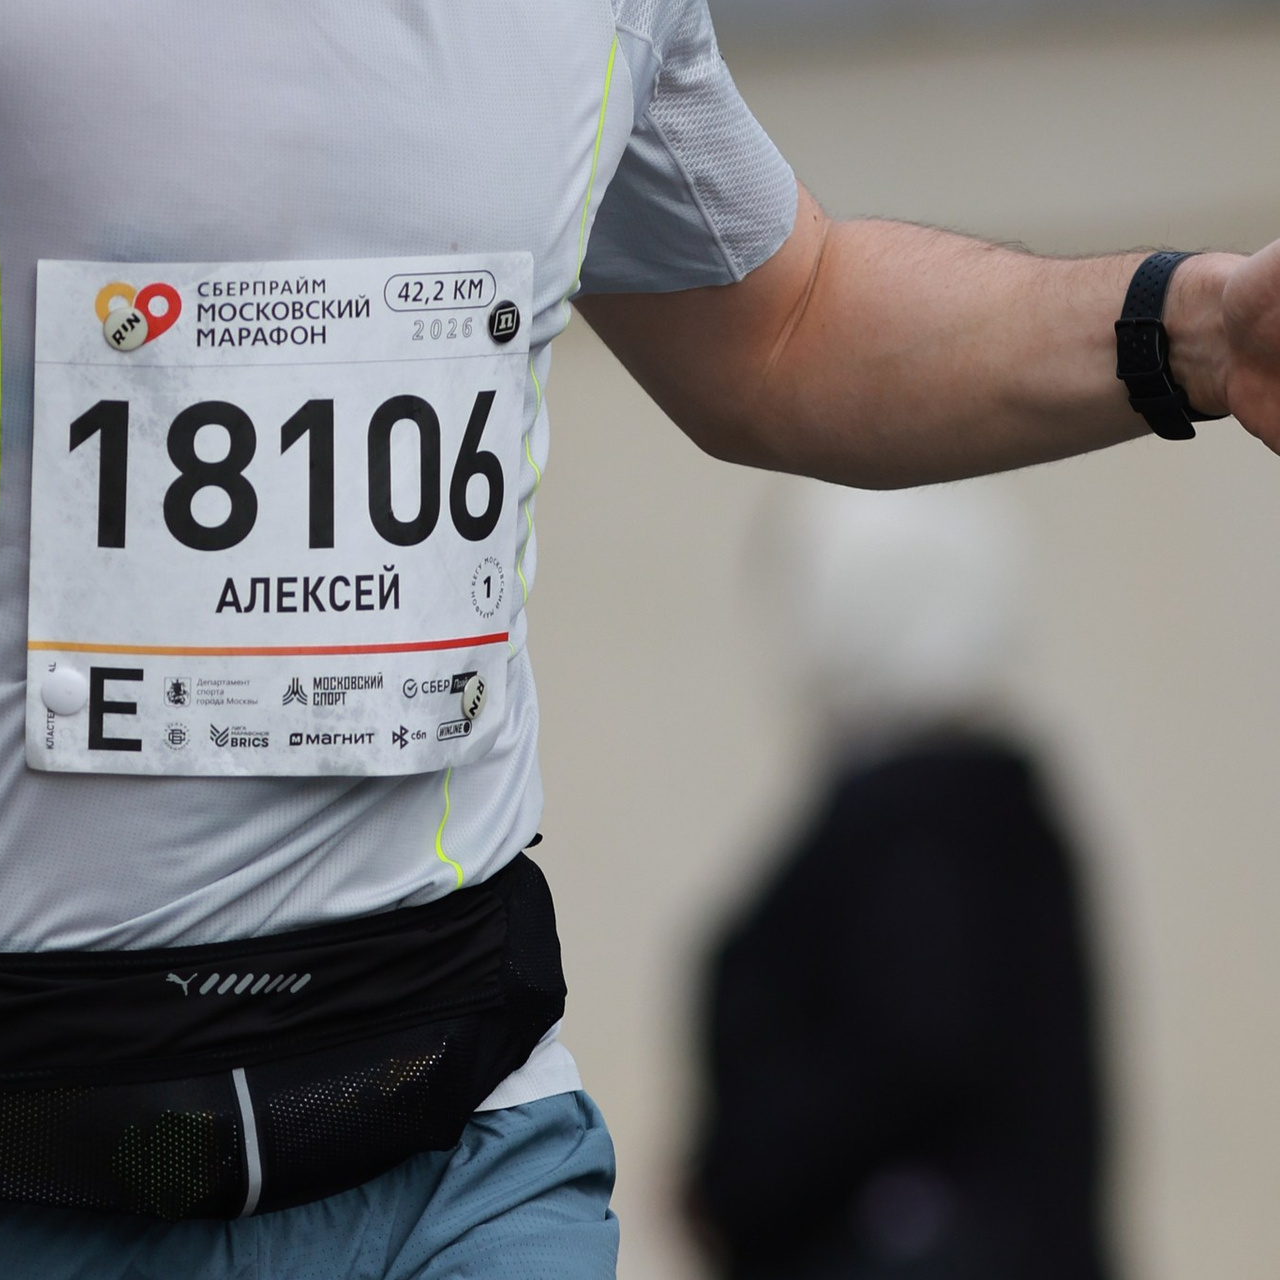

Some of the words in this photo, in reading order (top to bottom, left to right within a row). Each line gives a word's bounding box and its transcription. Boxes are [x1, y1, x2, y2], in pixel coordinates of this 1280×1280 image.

[197, 278, 327, 298] СБЕРПРАЙМ
[397, 280, 446, 305] 42,2
[196, 294, 371, 323] МОСКОВСКИЙ
[196, 324, 327, 348] МАРАФОН
[412, 318, 474, 342] 2026
[69, 390, 505, 552] 18106
[215, 564, 400, 614] АЛЕКСЕЙ
[483, 575, 492, 599] 1
[196, 678, 250, 687] Департамент
[312, 672, 384, 691] МОСКОВСКИЙ
[421, 679, 451, 694] СБЕР
[196, 698, 225, 706] города
[312, 691, 348, 706] СПОРТ
[439, 723, 463, 737] WINLINE
[230, 737, 270, 748] BRICS
